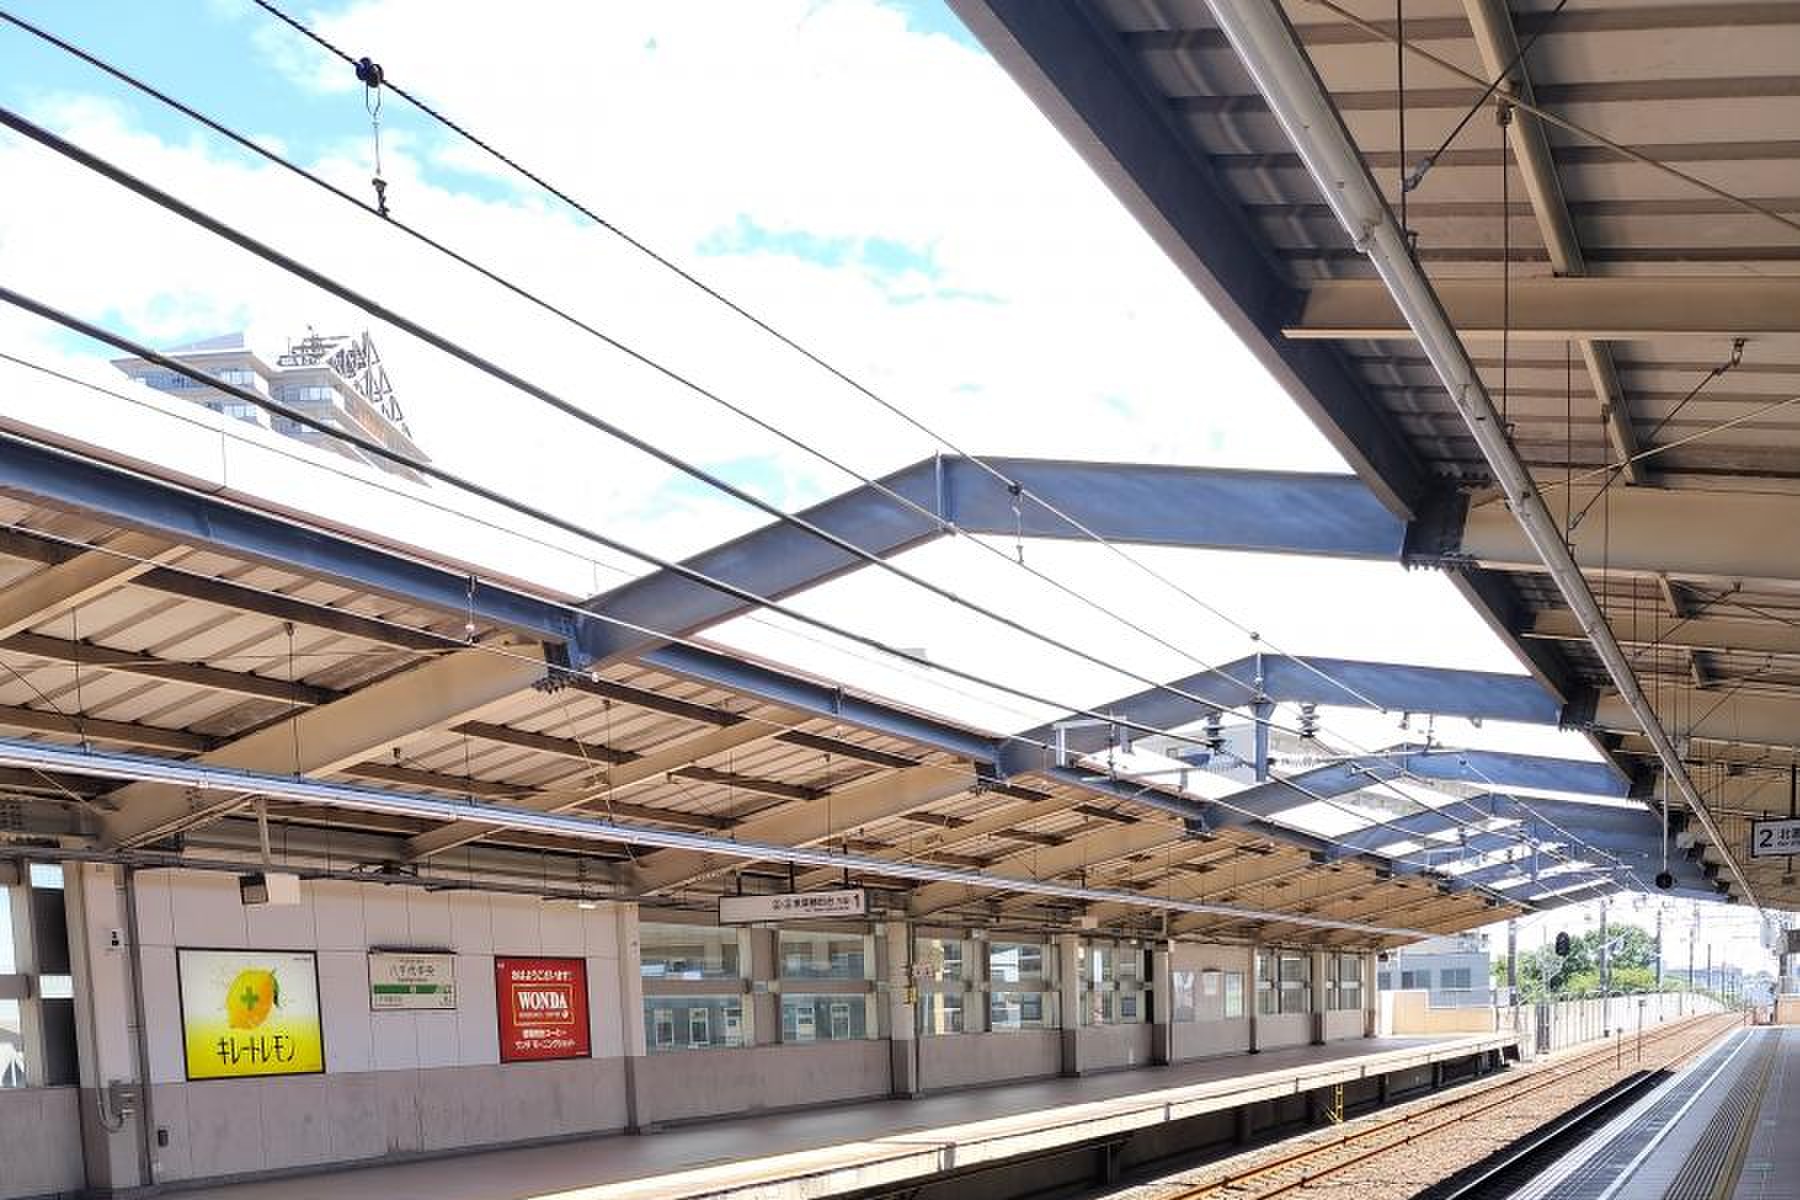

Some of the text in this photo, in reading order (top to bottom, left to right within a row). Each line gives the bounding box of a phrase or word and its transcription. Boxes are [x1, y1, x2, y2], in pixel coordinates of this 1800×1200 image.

[1759, 829, 1773, 847] 2
[853, 894, 861, 909] 1
[518, 991, 569, 1010] WONDA
[216, 1034, 296, 1066] キレートレモン
